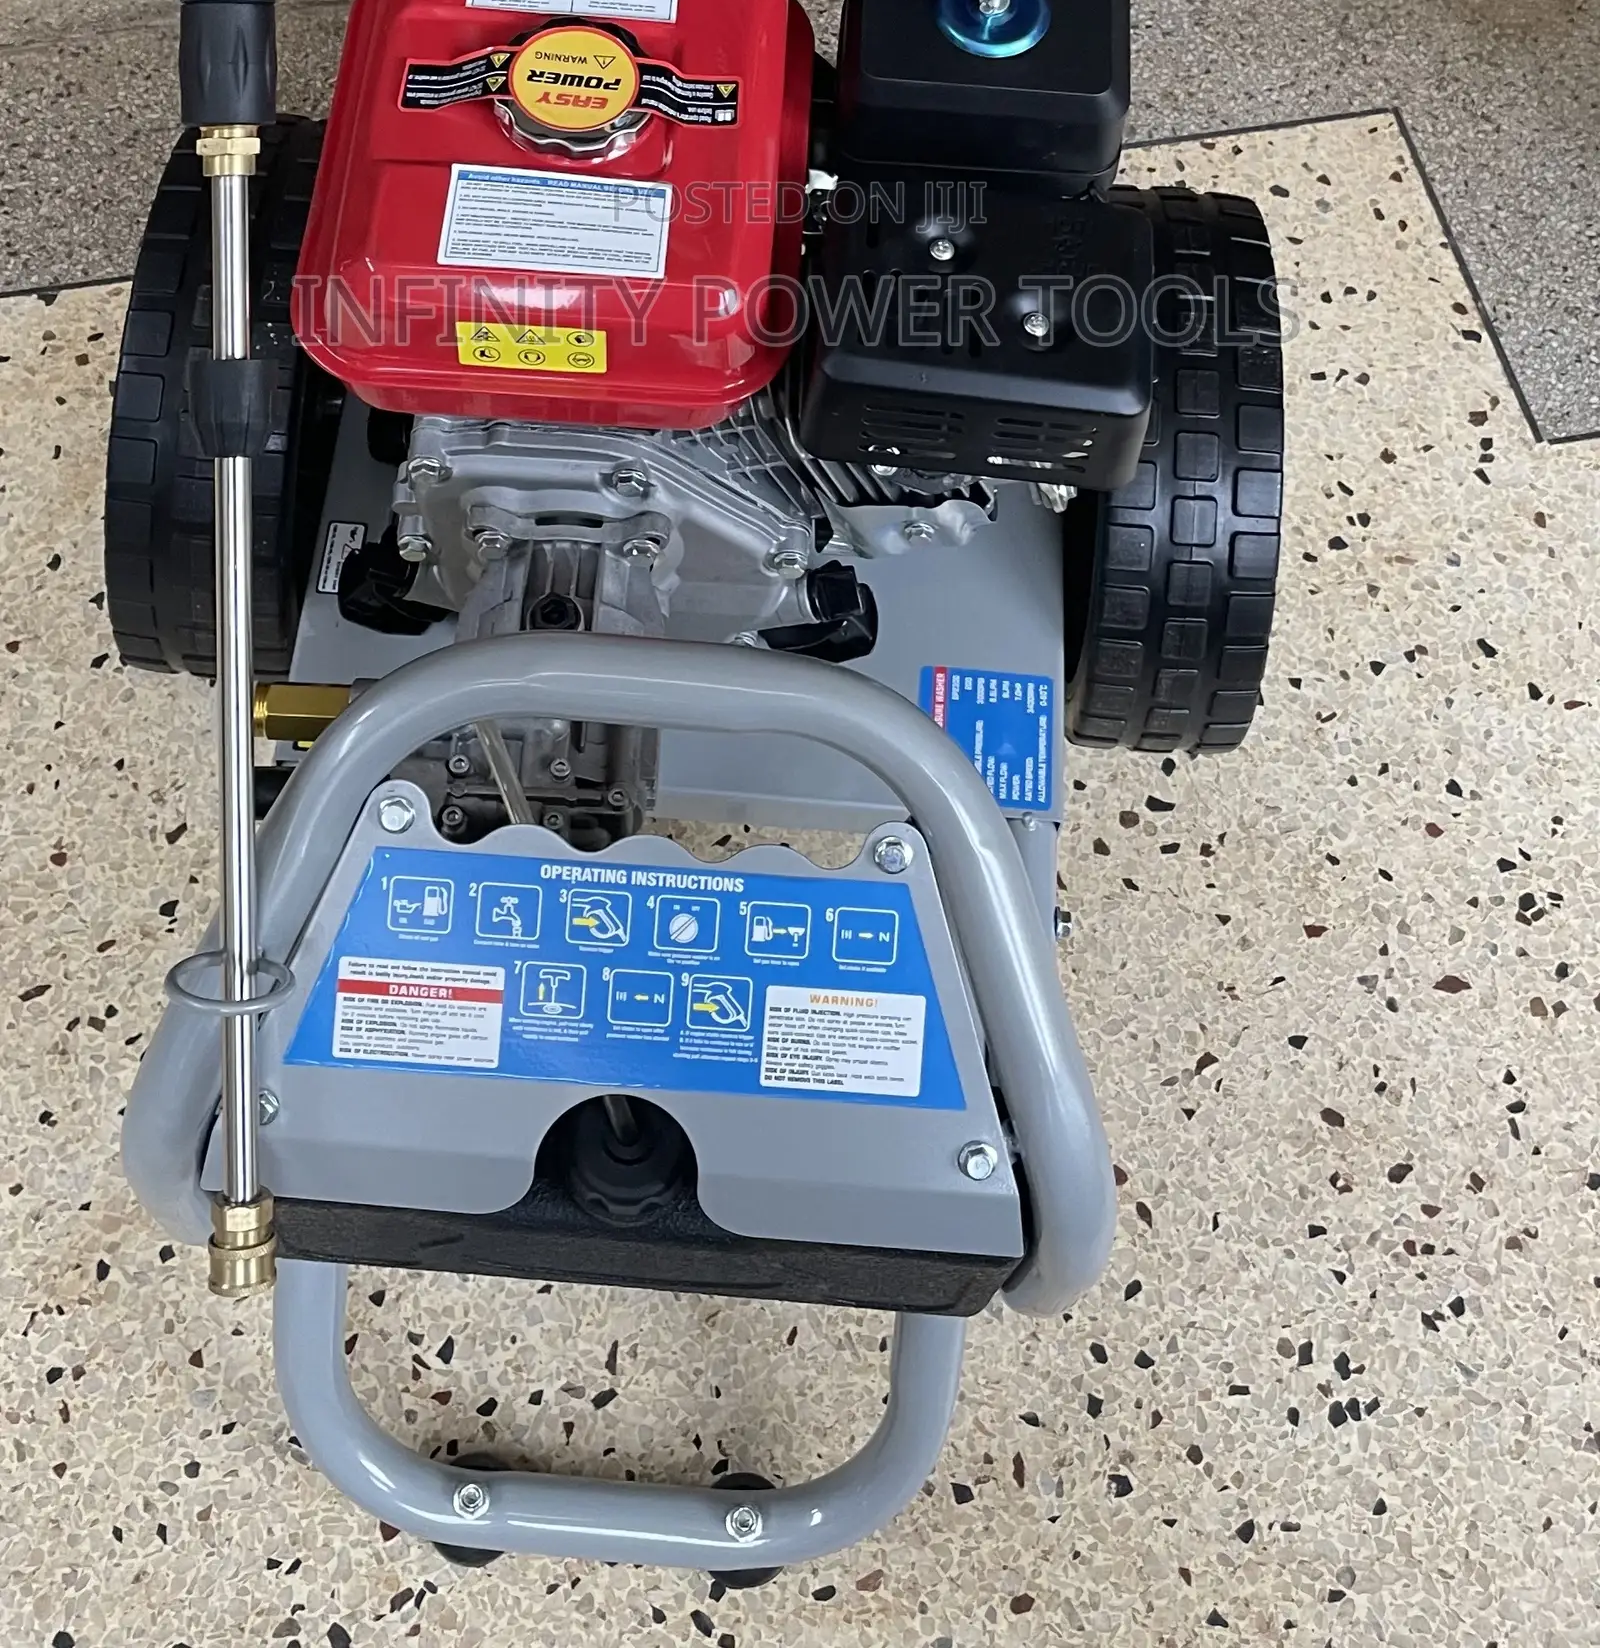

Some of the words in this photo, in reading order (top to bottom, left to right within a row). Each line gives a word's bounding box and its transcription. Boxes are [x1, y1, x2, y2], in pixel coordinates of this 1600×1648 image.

[535, 51, 588, 65] WARNING
[526, 69, 623, 91] POWER
[535, 91, 609, 110] EASY
[467, 172, 492, 181] Avoid
[493, 174, 510, 182] other
[380, 877, 388, 891] 1
[540, 864, 627, 885] OPERATING
[631, 870, 745, 893] INSTRUCTIONS
[468, 883, 477, 897] 2
[559, 889, 567, 903] 3
[646, 895, 655, 909] 4
[739, 902, 747, 916] 5
[825, 908, 834, 922] 6
[514, 960, 522, 975] 7
[602, 967, 610, 981] 8
[681, 973, 689, 987] 9
[389, 984, 453, 999] DANGER!
[809, 994, 878, 1008] WARNING!
